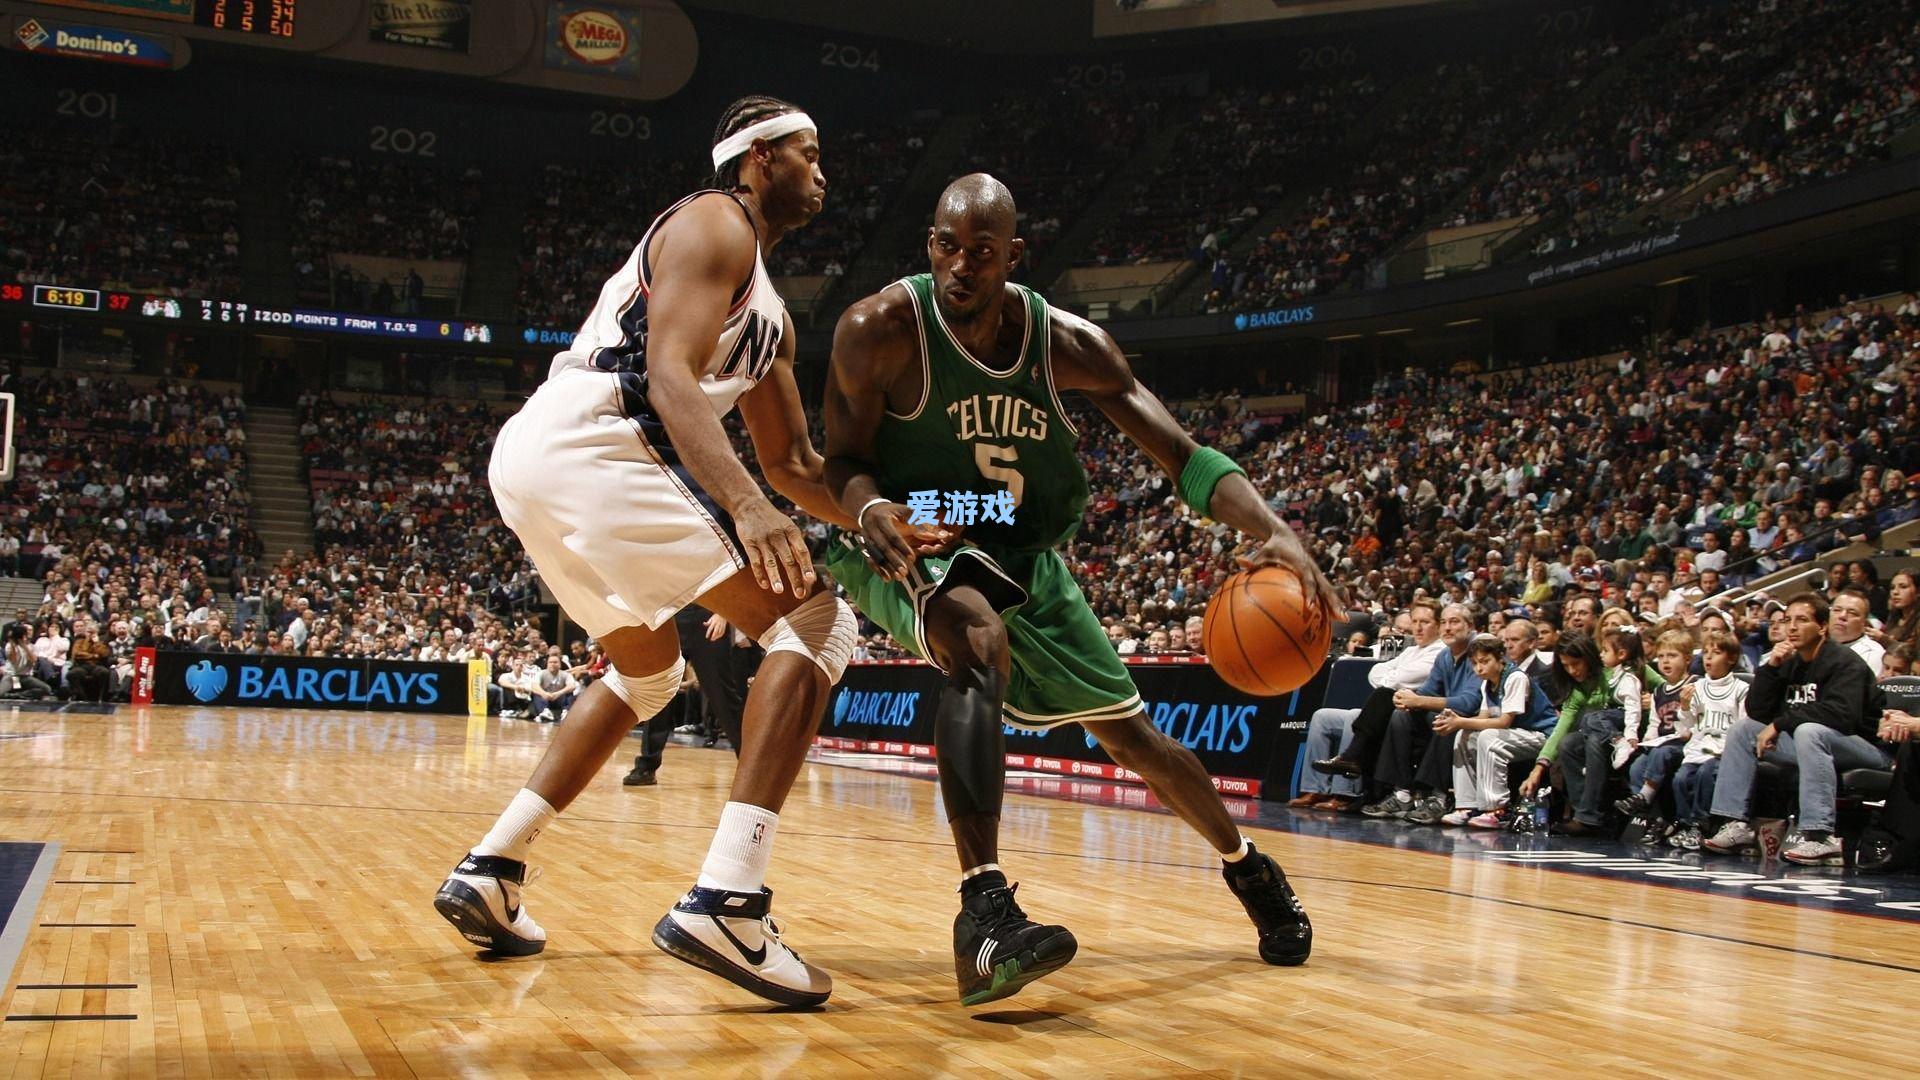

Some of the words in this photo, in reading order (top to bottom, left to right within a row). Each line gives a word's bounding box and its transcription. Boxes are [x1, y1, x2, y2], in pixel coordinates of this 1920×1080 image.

[1535, 7, 1595, 37] 207
[56, 30, 138, 56] Domino's
[820, 43, 880, 72] 204
[1296, 44, 1357, 71] 206
[1067, 62, 1127, 88] 205
[57, 88, 118, 119] 201
[589, 110, 651, 140] 203
[369, 125, 437, 157] 202
[1, 284, 23, 300] 36
[47, 290, 85, 306] 6:19
[108, 294, 130, 310] 37
[202, 309, 212, 320] 2
[238, 312, 245, 323] 1
[254, 310, 293, 324] IZOD
[295, 313, 338, 326] POINTS
[344, 318, 377, 330] FROM
[440, 323, 450, 336] 6
[1250, 306, 1314, 327] BARCLAYS
[540, 330, 578, 344] BARC
[716, 308, 780, 384] NE
[946, 394, 1048, 441] CELTICS
[974, 442, 1025, 511] 5
[238, 665, 439, 705] BARCLAYS
[846, 691, 921, 727] BARCLAYS
[1696, 709, 1734, 732] CLTIC
[1144, 702, 1258, 753] RCLAYS
[1042, 760, 1061, 770] TOYOTA
[1081, 764, 1102, 776] TOYOTA
[1222, 781, 1248, 792] TOYOTA
